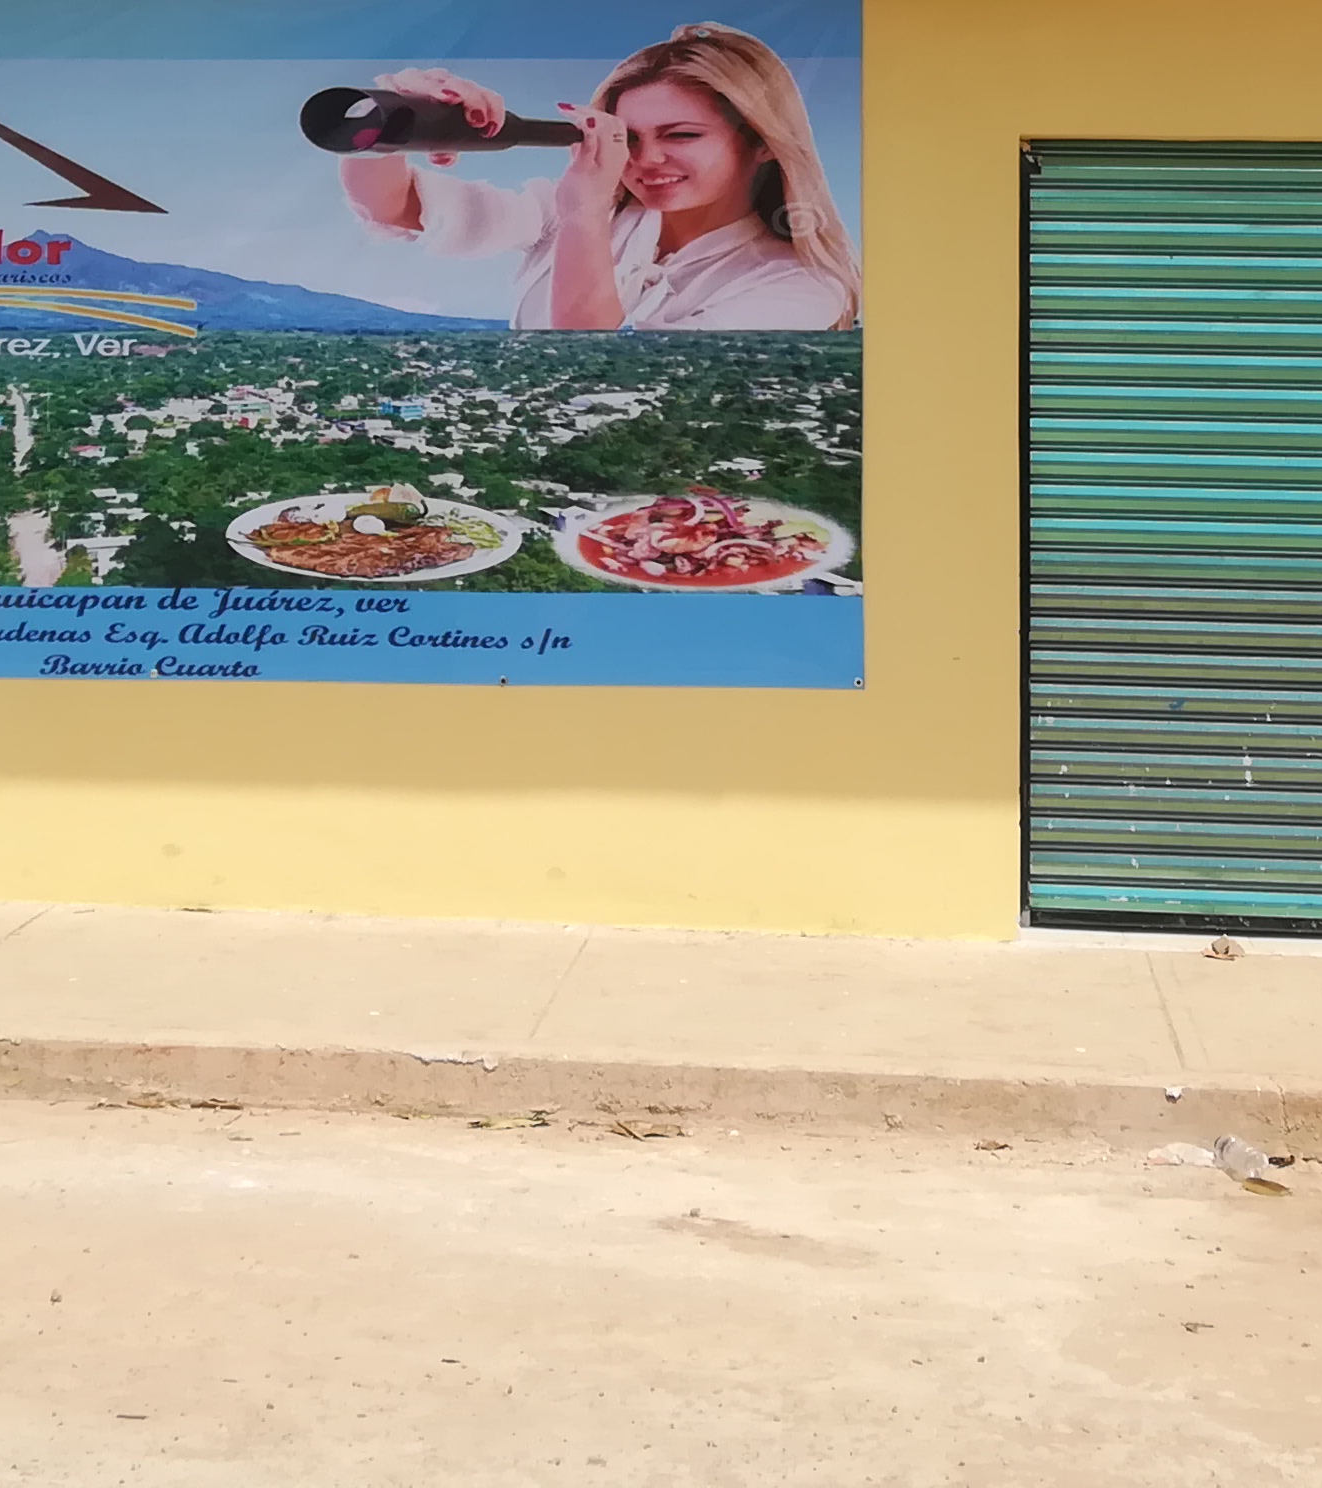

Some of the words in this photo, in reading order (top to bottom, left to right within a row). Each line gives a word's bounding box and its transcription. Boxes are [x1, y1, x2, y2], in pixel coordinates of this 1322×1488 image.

[157, 588, 199, 611] de
[208, 588, 346, 618] Juárez,
[355, 597, 411, 613] ver
[103, 623, 168, 650] Esq.
[178, 623, 289, 650] Adolfo
[297, 625, 380, 646] Ruiz
[387, 626, 510, 650] Cortines
[519, 628, 573, 655] s/n
[38, 654, 146, 676] Barrio
[154, 656, 264, 678] Cuarto
